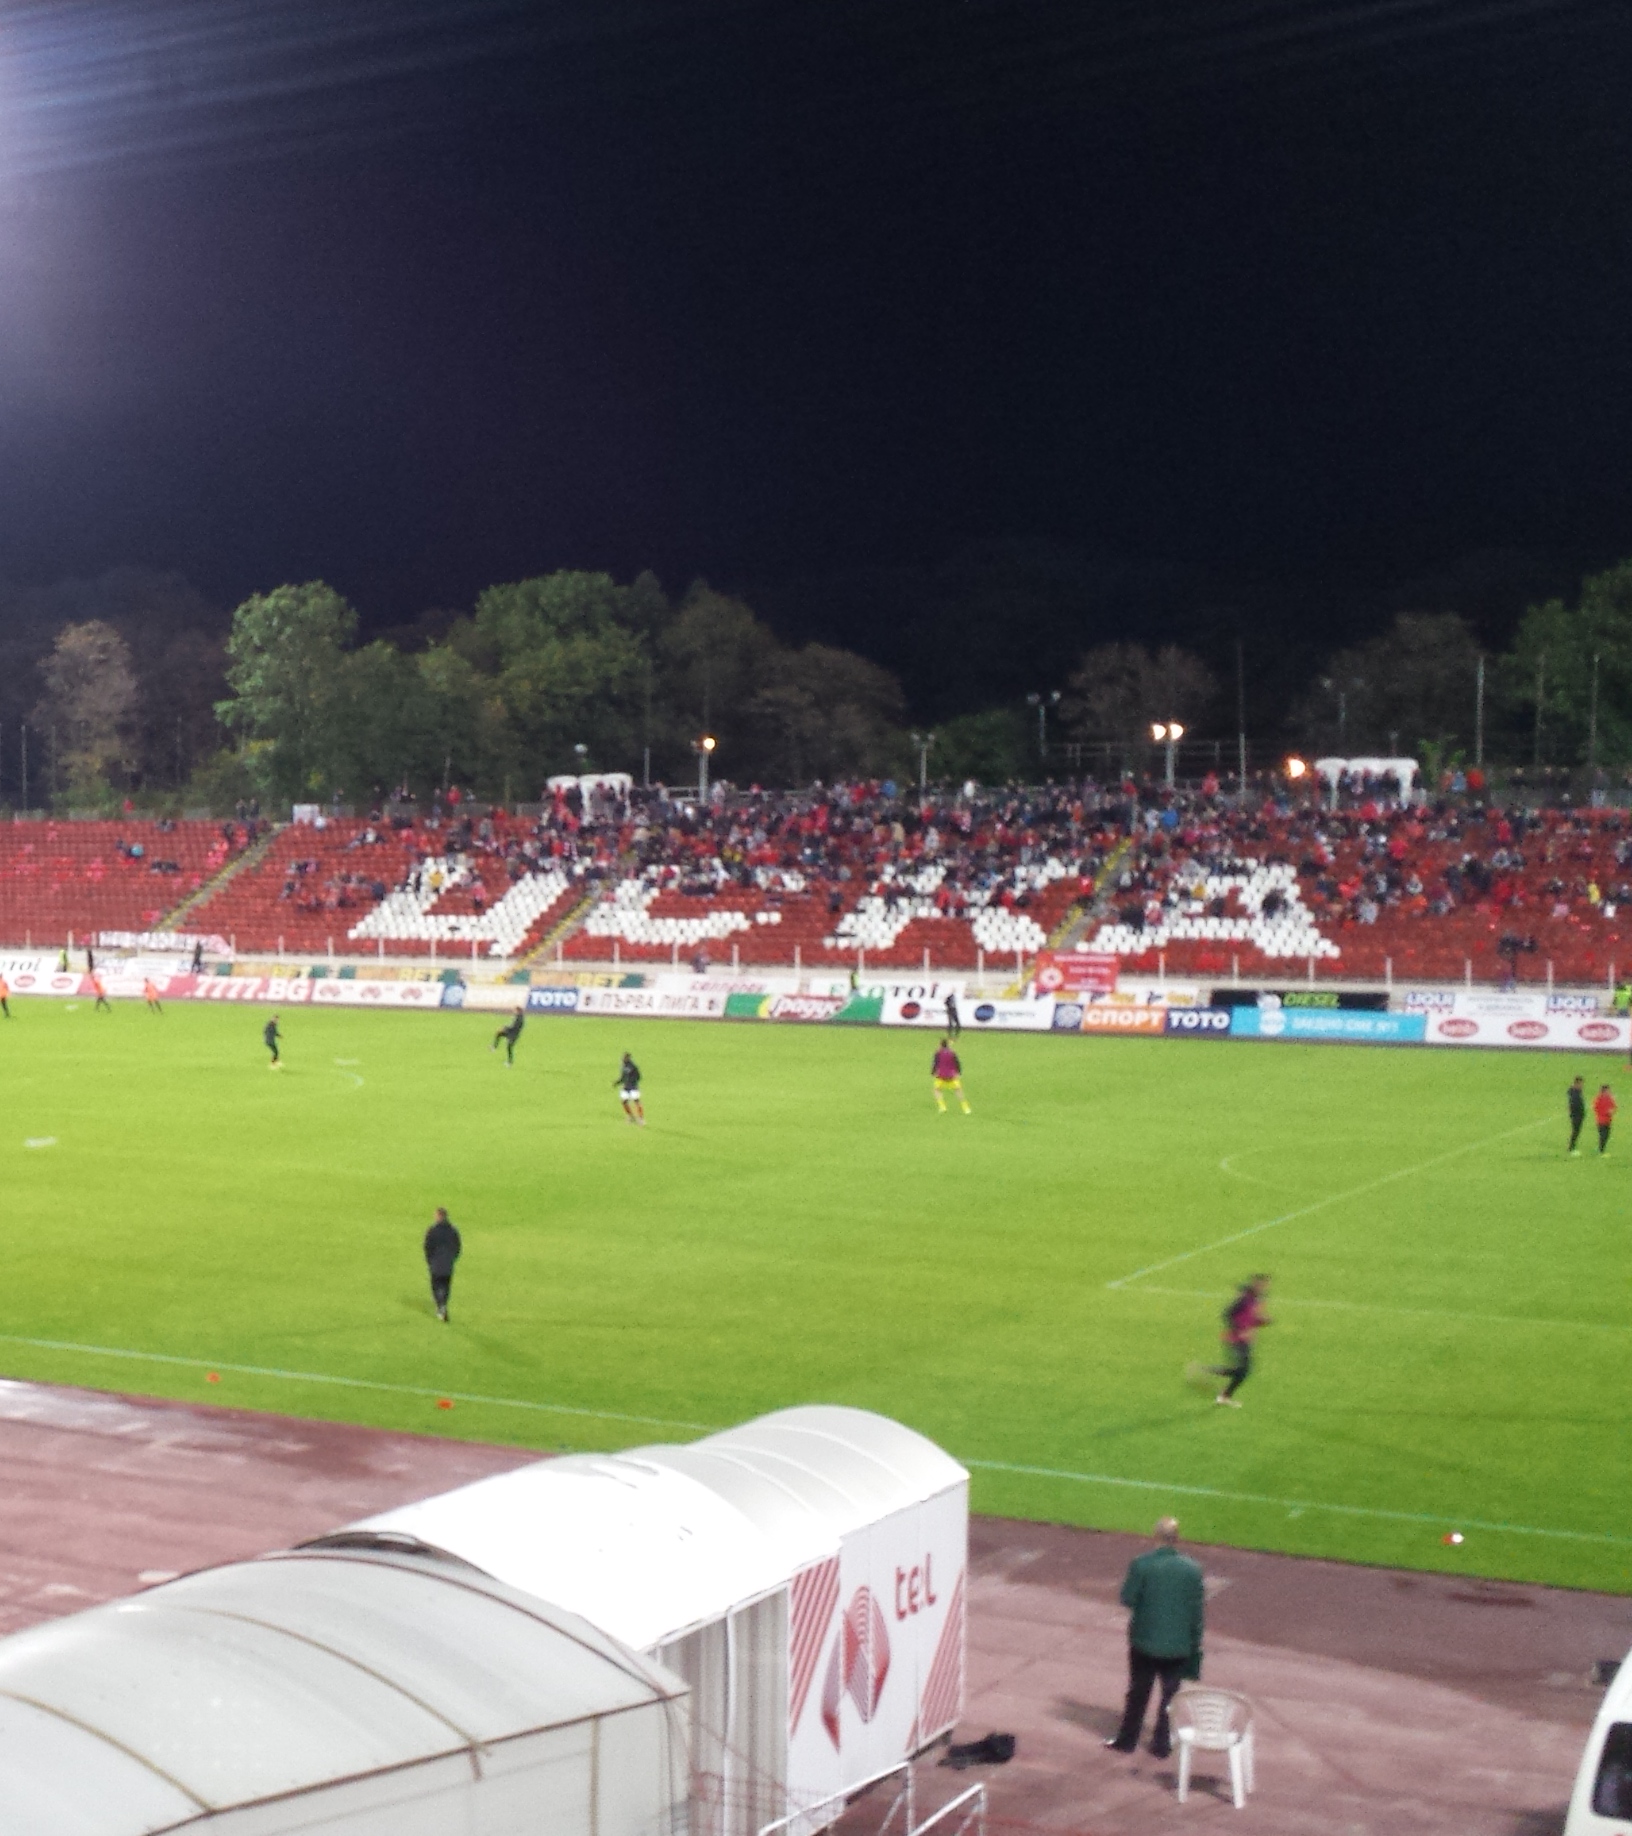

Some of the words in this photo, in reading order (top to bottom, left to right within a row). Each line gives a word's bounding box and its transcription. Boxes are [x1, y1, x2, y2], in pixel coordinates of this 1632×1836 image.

[1086, 1008, 1160, 1027] СПОРТ
[1170, 1011, 1231, 1030] ТОТО
[894, 1552, 937, 1621] tel
